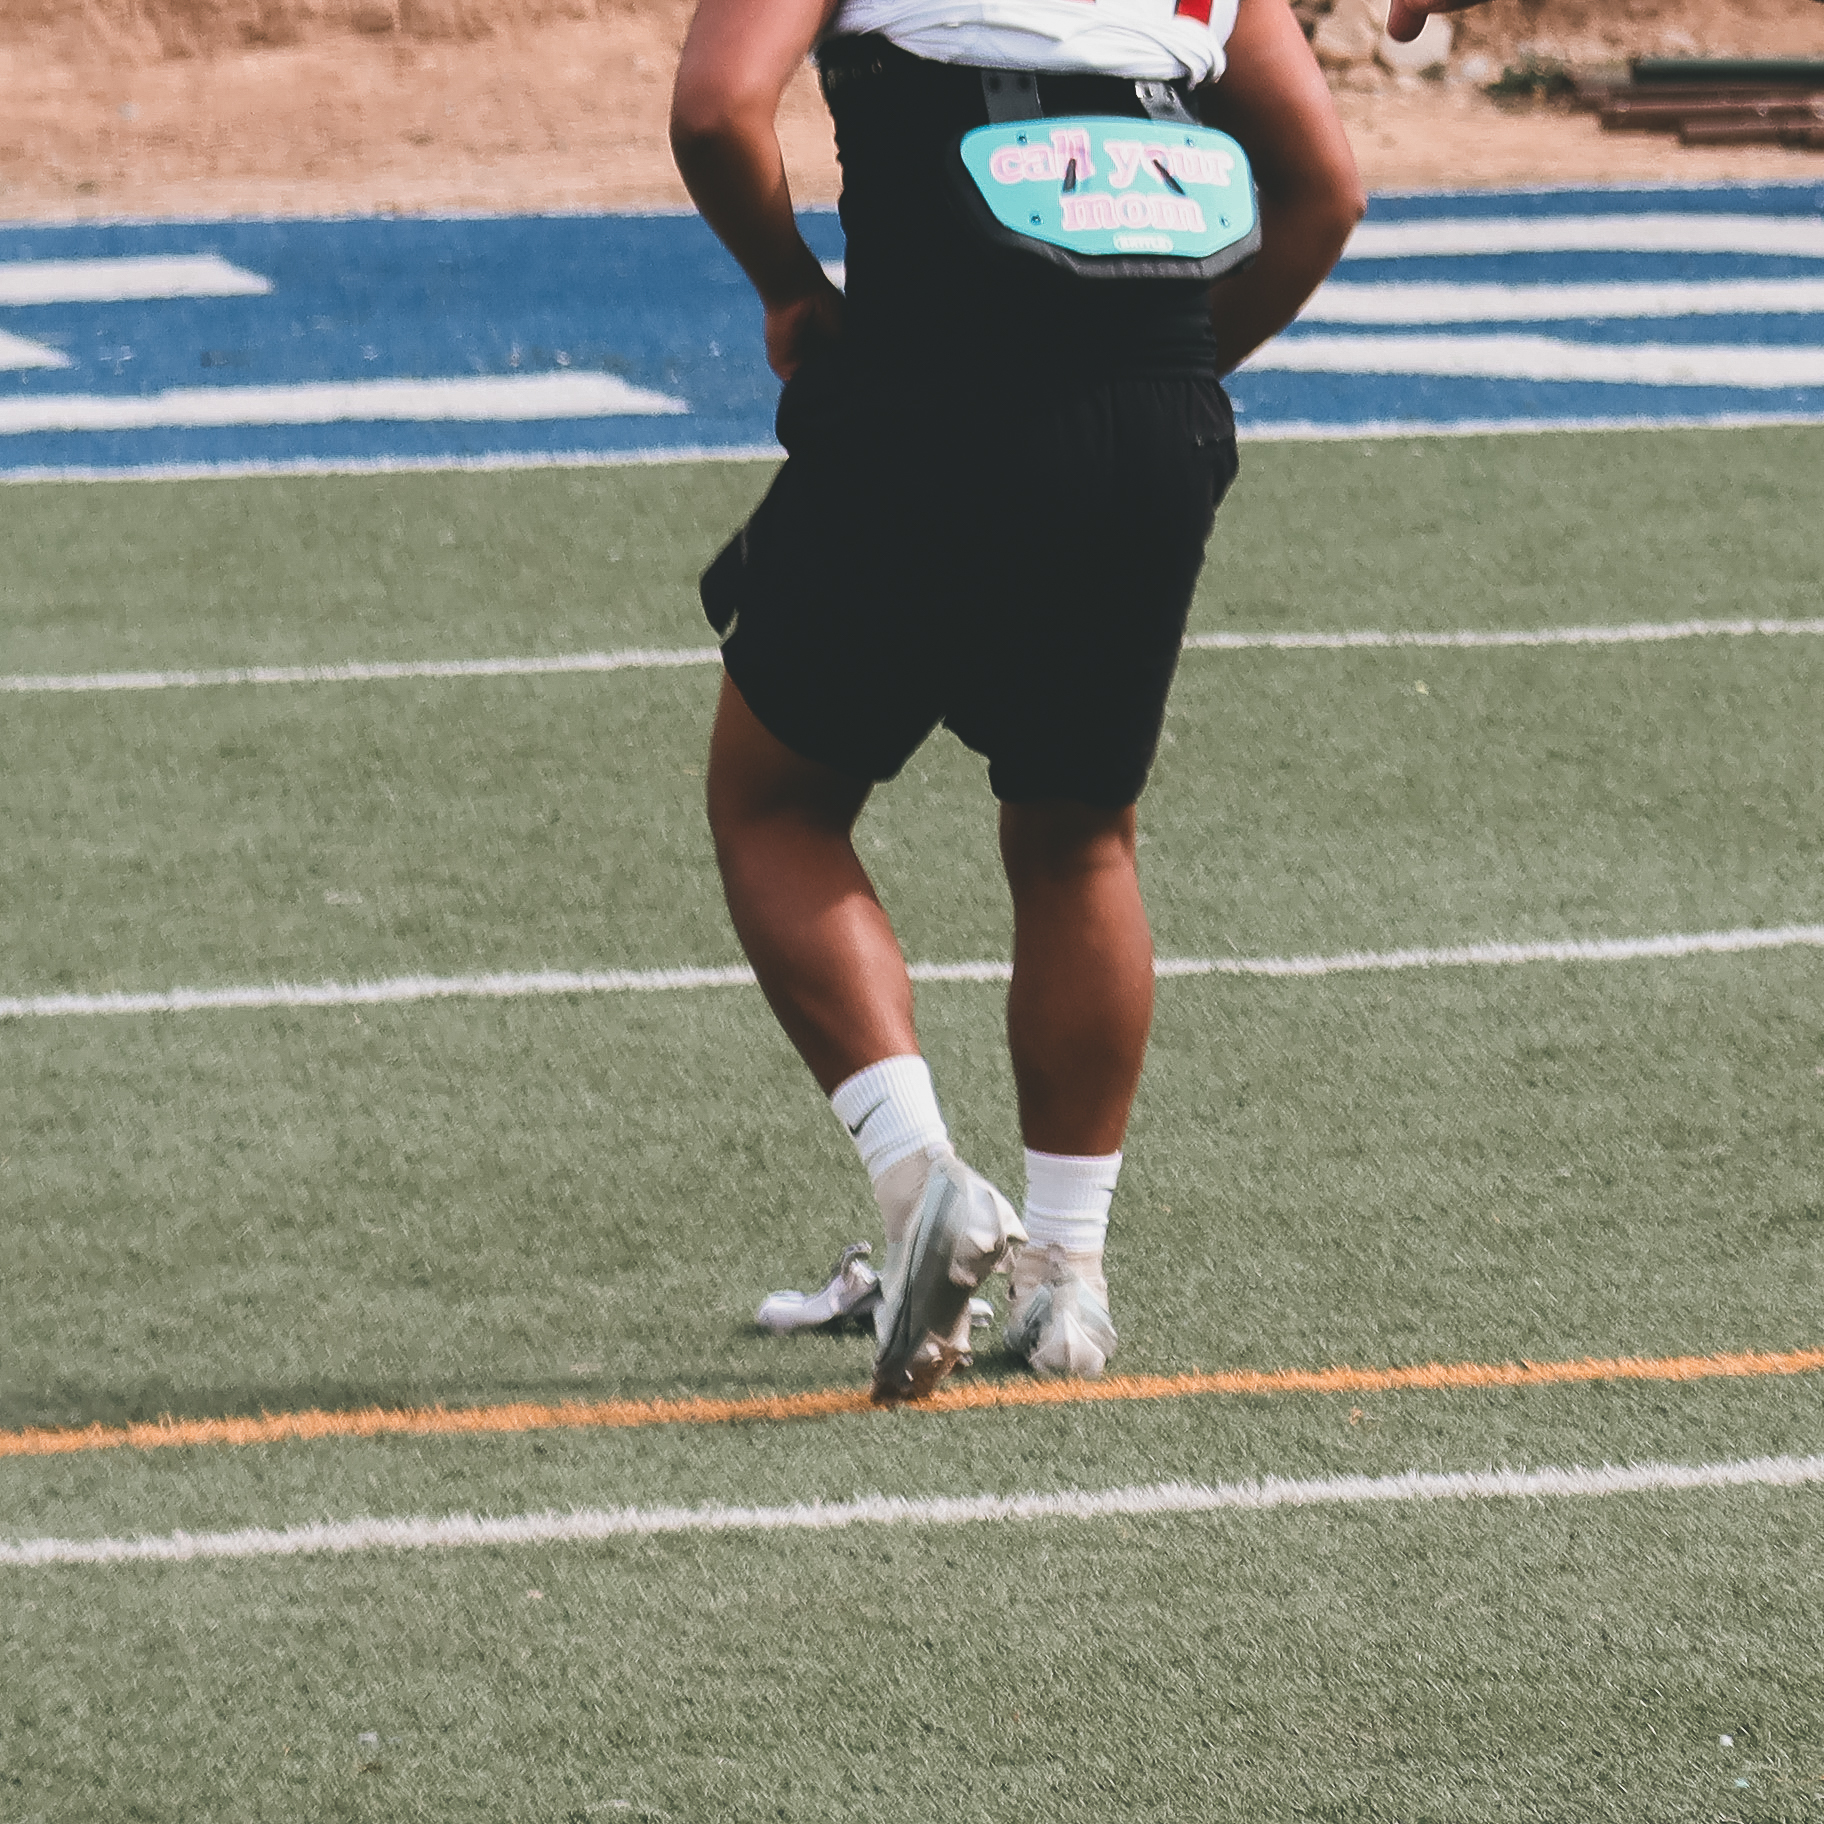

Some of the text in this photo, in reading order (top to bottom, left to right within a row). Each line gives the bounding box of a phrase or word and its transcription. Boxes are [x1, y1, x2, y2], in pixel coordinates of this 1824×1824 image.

[990, 128, 1235, 189] call your
[1060, 191, 1207, 232] mom
